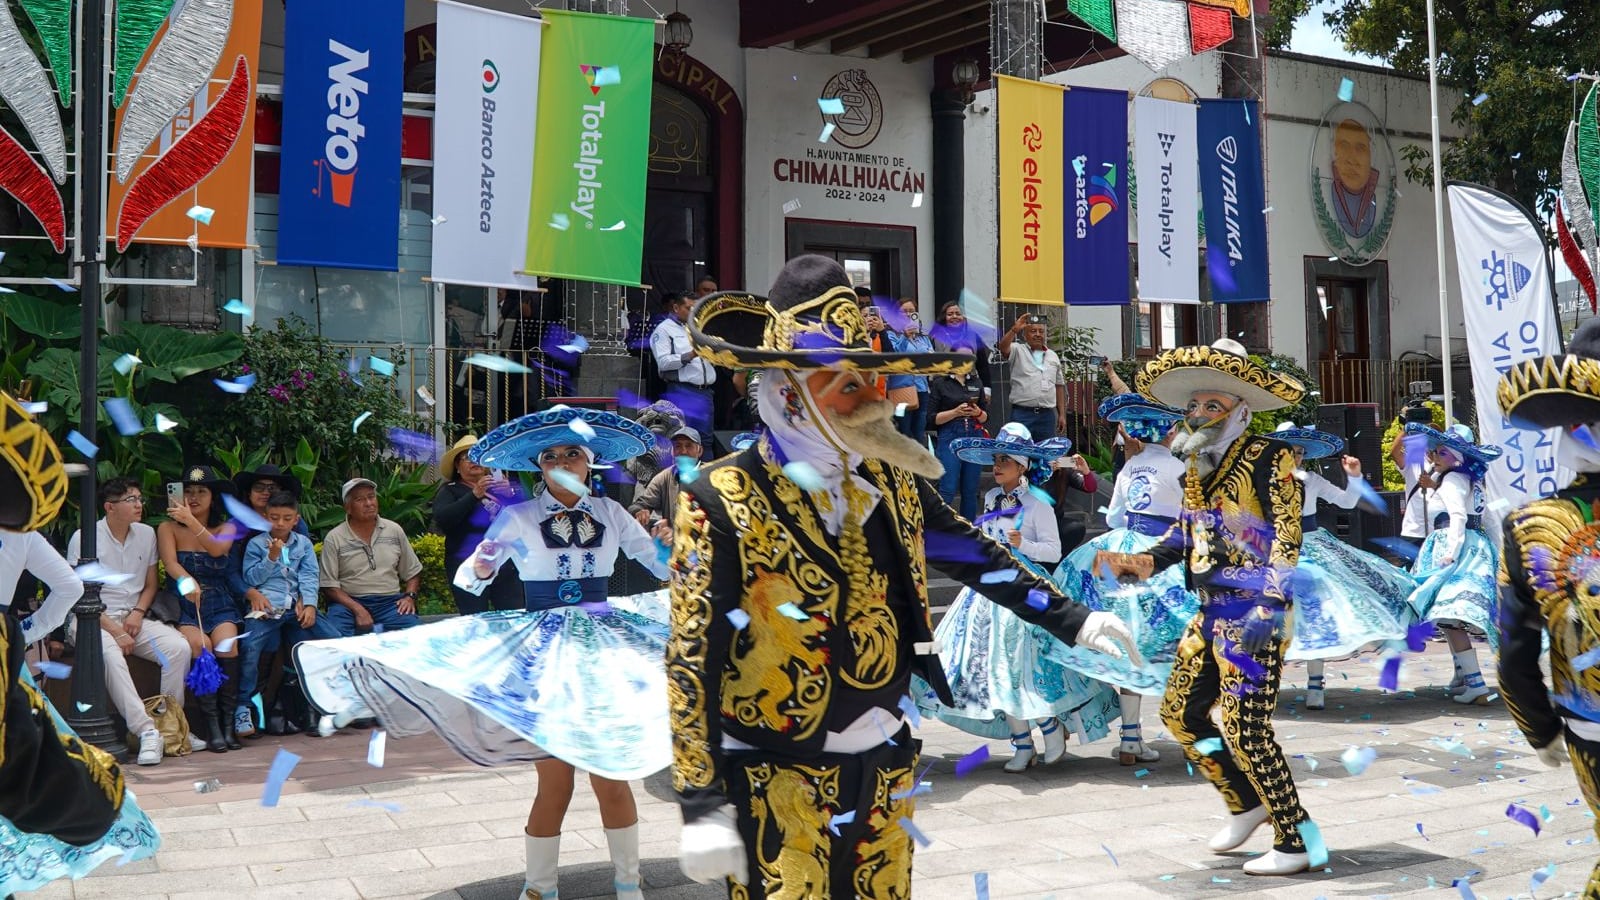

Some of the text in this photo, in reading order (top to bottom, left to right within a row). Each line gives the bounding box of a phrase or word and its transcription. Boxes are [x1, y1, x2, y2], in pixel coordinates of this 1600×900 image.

[325, 38, 370, 171] Neto
[659, 53, 734, 115] CIPAL
[480, 97, 496, 233] Banco Azteca
[773, 158, 925, 193] CHIMALHUACÁN
[892, 156, 905, 168] DE
[1022, 157, 1042, 262] elektra
[1158, 162, 1174, 259] Totalplay
[1221, 163, 1243, 261] ITALIKA
[1492, 330, 1528, 494] ACAIA
[1519, 320, 1553, 448] MJO
[1535, 456, 1558, 498] DE
